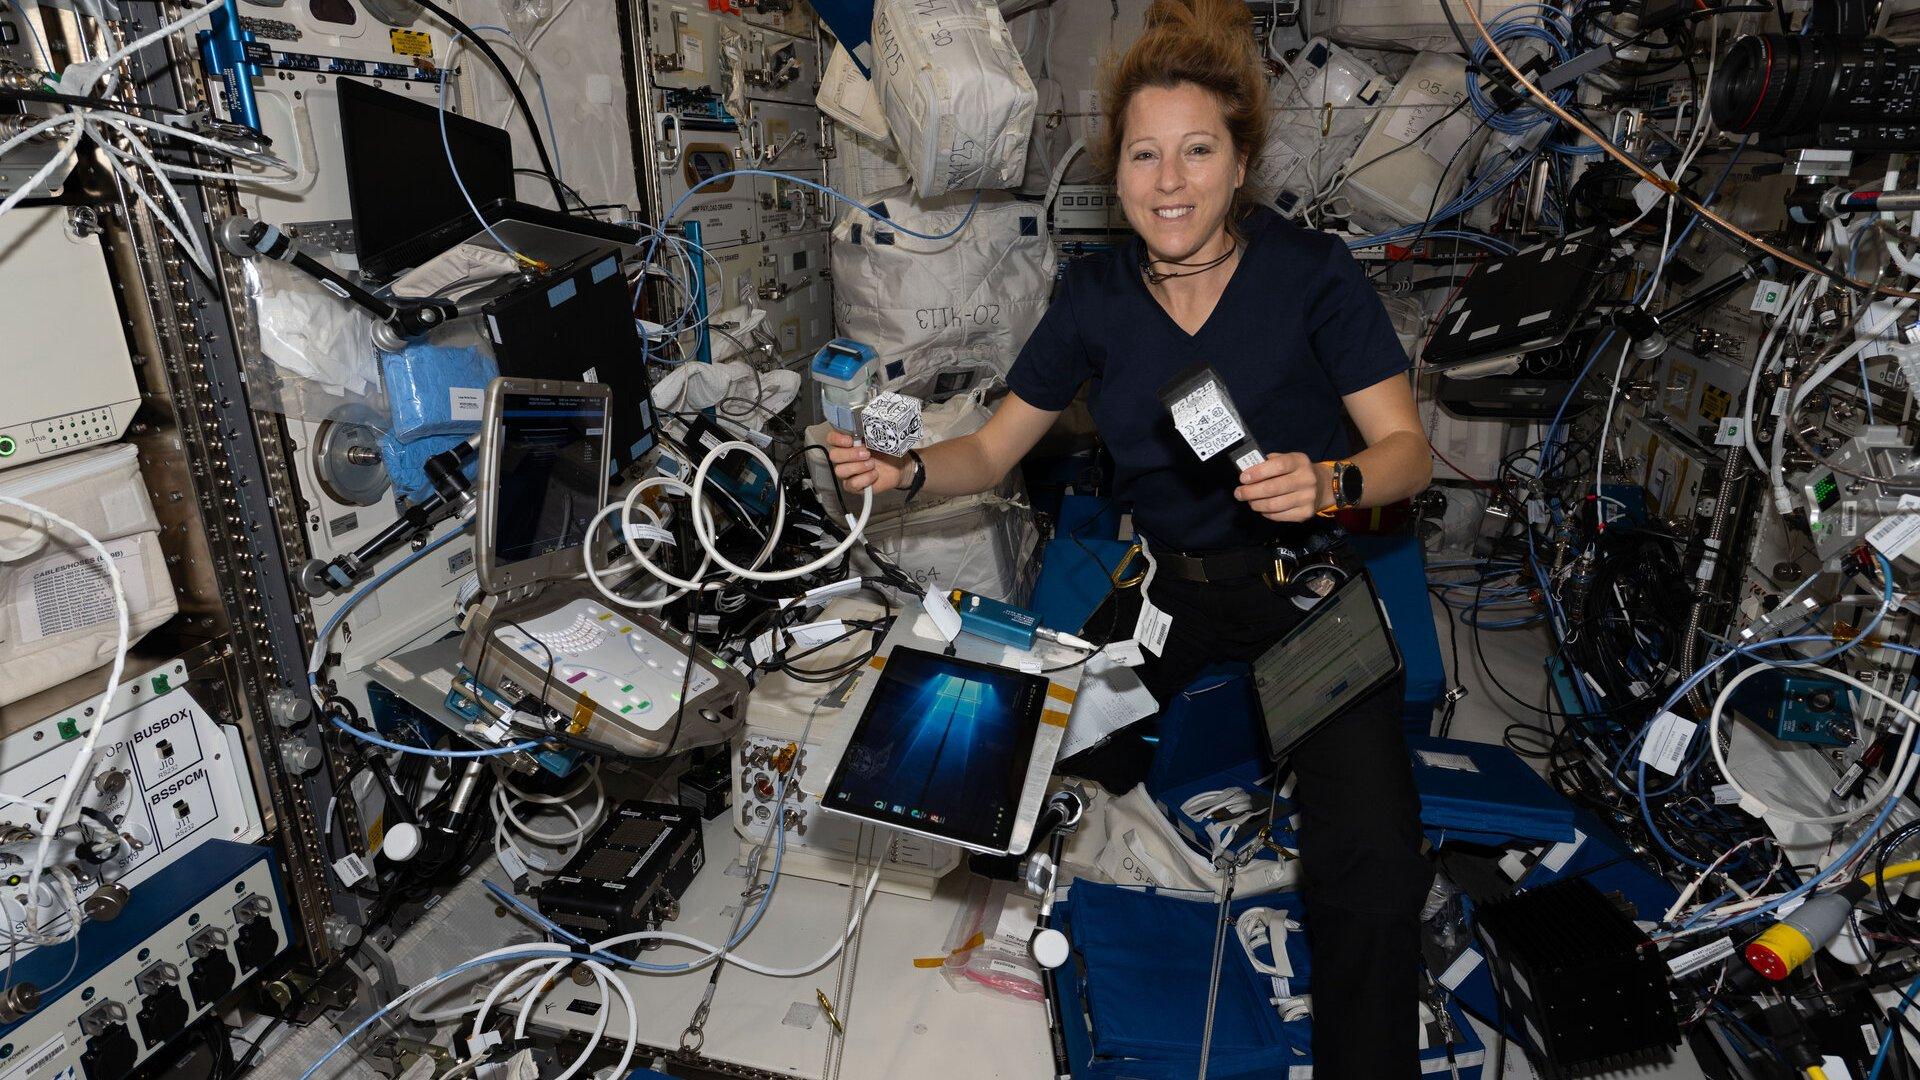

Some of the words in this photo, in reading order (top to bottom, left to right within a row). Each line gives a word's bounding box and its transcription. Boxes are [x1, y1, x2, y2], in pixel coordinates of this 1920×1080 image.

[25, 435, 46, 445] STATUS
[33, 557, 95, 580] CABLES/HOSES
[133, 708, 189, 744] BUSBOX
[160, 757, 175, 771] J10
[150, 768, 205, 806] BSSPCM
[7, 1045, 30, 1062] POWER
